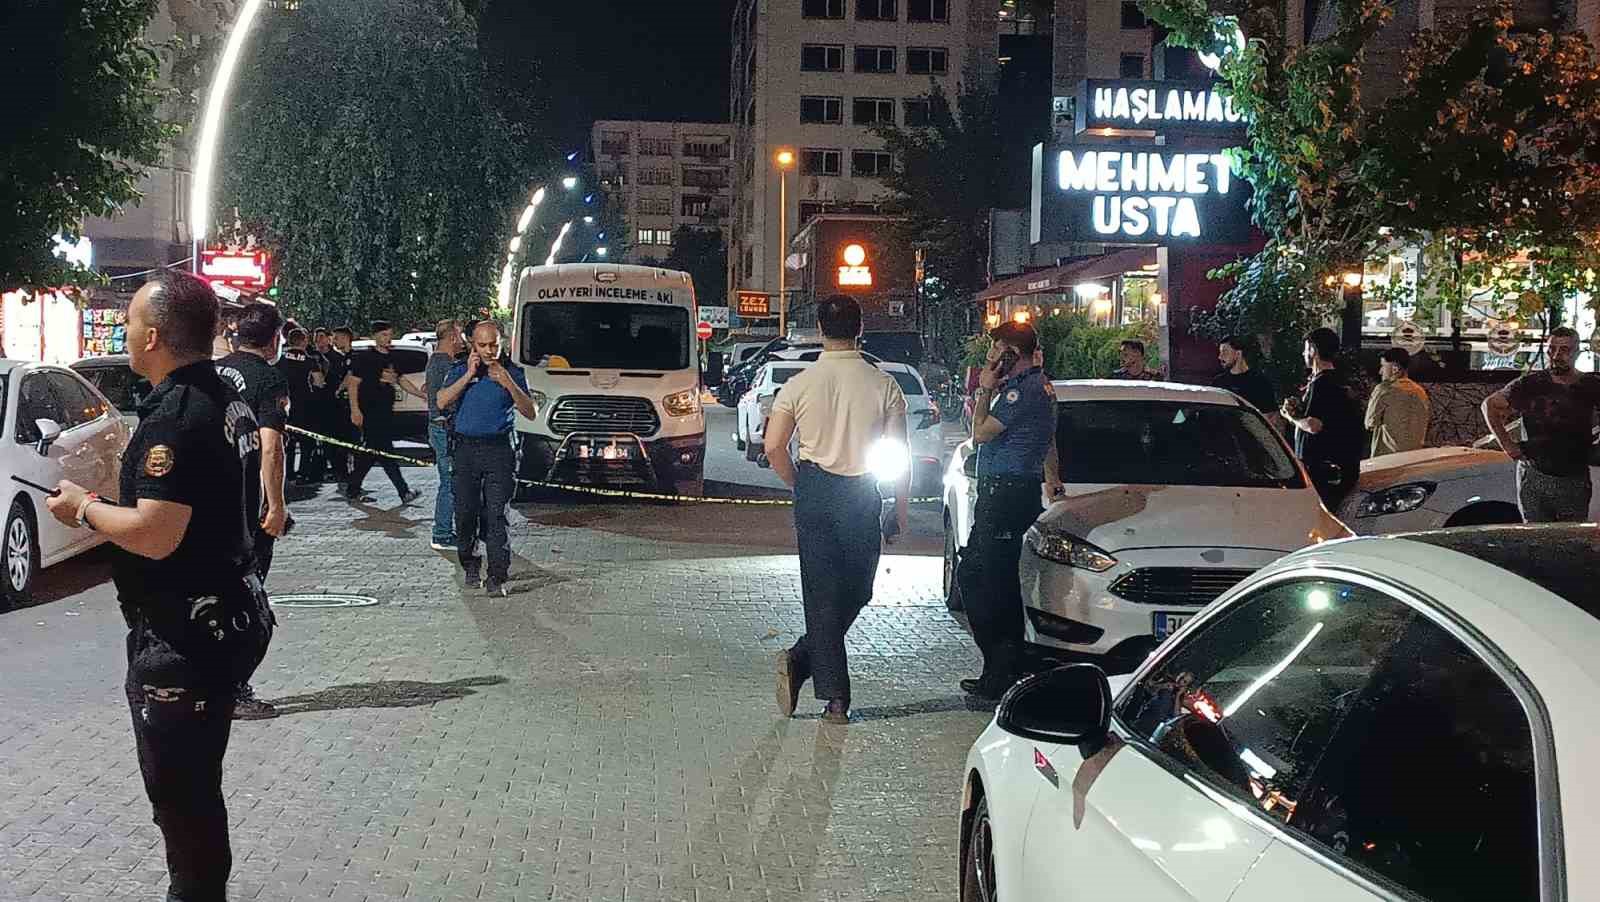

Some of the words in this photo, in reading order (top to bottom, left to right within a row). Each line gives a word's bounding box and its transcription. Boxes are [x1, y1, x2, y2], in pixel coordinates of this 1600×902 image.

[1058, 149, 1232, 194] MEHMET
[1092, 195, 1201, 237] USTA
[538, 288, 567, 299] OLAY
[569, 284, 593, 298] YERİ
[595, 285, 647, 300] İNCELEME
[740, 296, 766, 305] ZEZ
